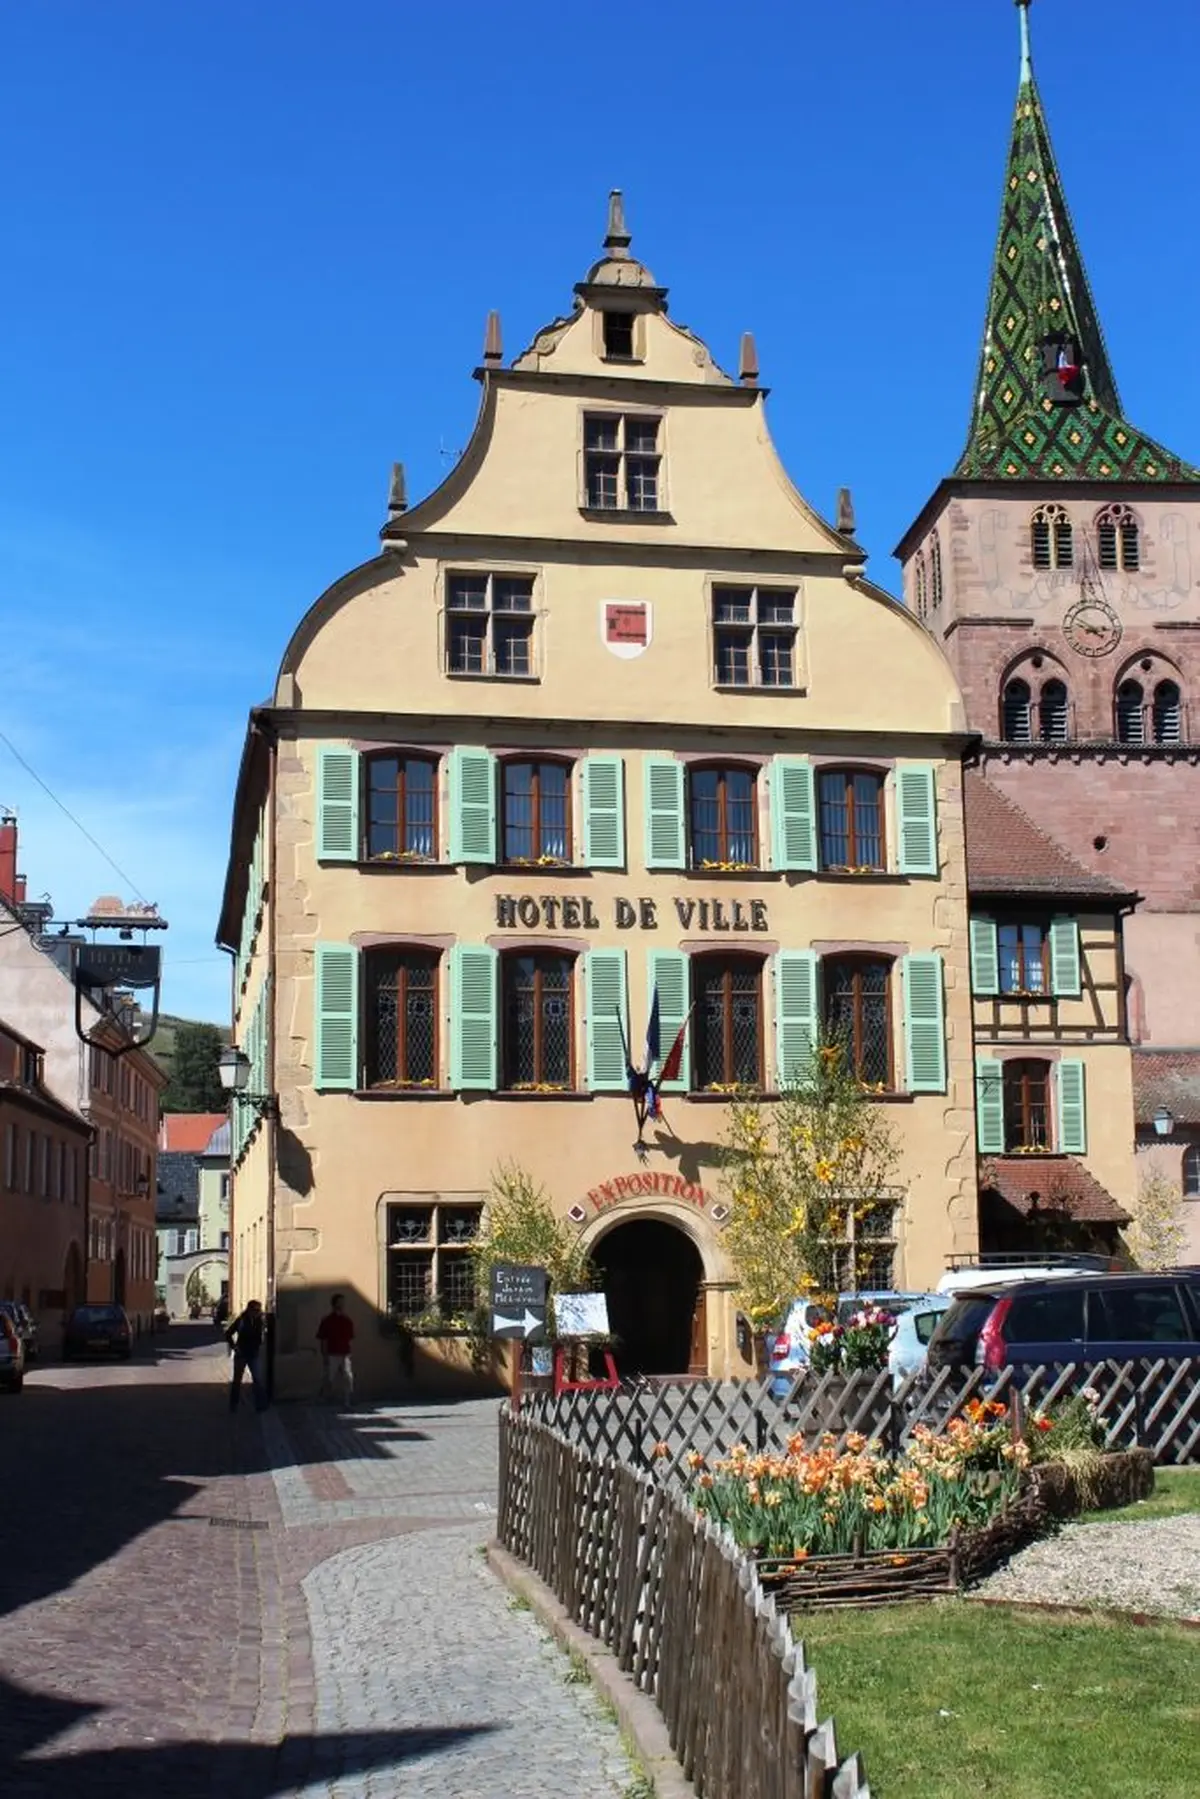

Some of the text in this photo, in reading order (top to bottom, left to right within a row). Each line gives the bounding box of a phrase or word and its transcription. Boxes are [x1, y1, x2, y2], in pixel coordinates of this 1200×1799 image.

[494, 894, 768, 931] HOTEL DE VILLE
[588, 1172, 705, 1210] EXPOSITION
